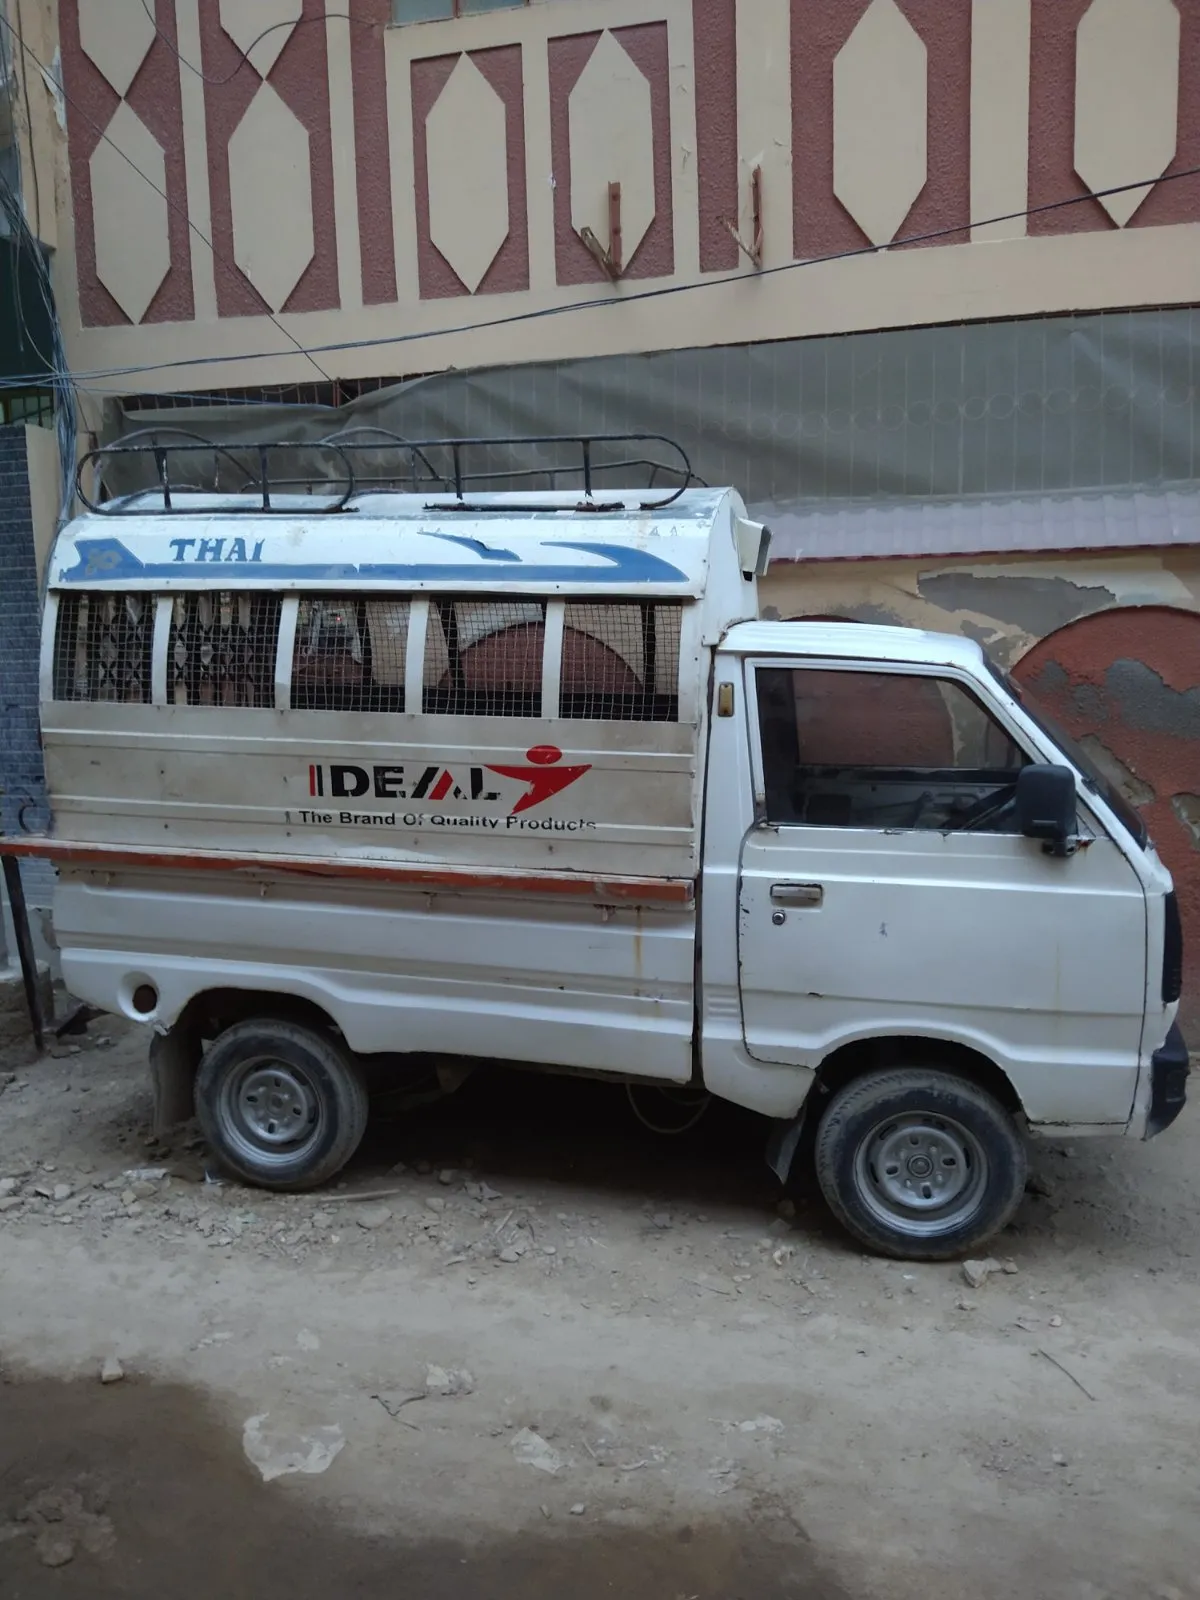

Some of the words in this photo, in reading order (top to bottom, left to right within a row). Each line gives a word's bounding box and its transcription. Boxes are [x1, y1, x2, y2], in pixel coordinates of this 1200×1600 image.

[169, 537, 266, 562] THAI
[309, 764, 502, 801] IDEAL
[298, 810, 333, 824] The
[339, 811, 397, 826] Brand
[430, 814, 500, 830] Quality
[505, 815, 597, 832] Products
